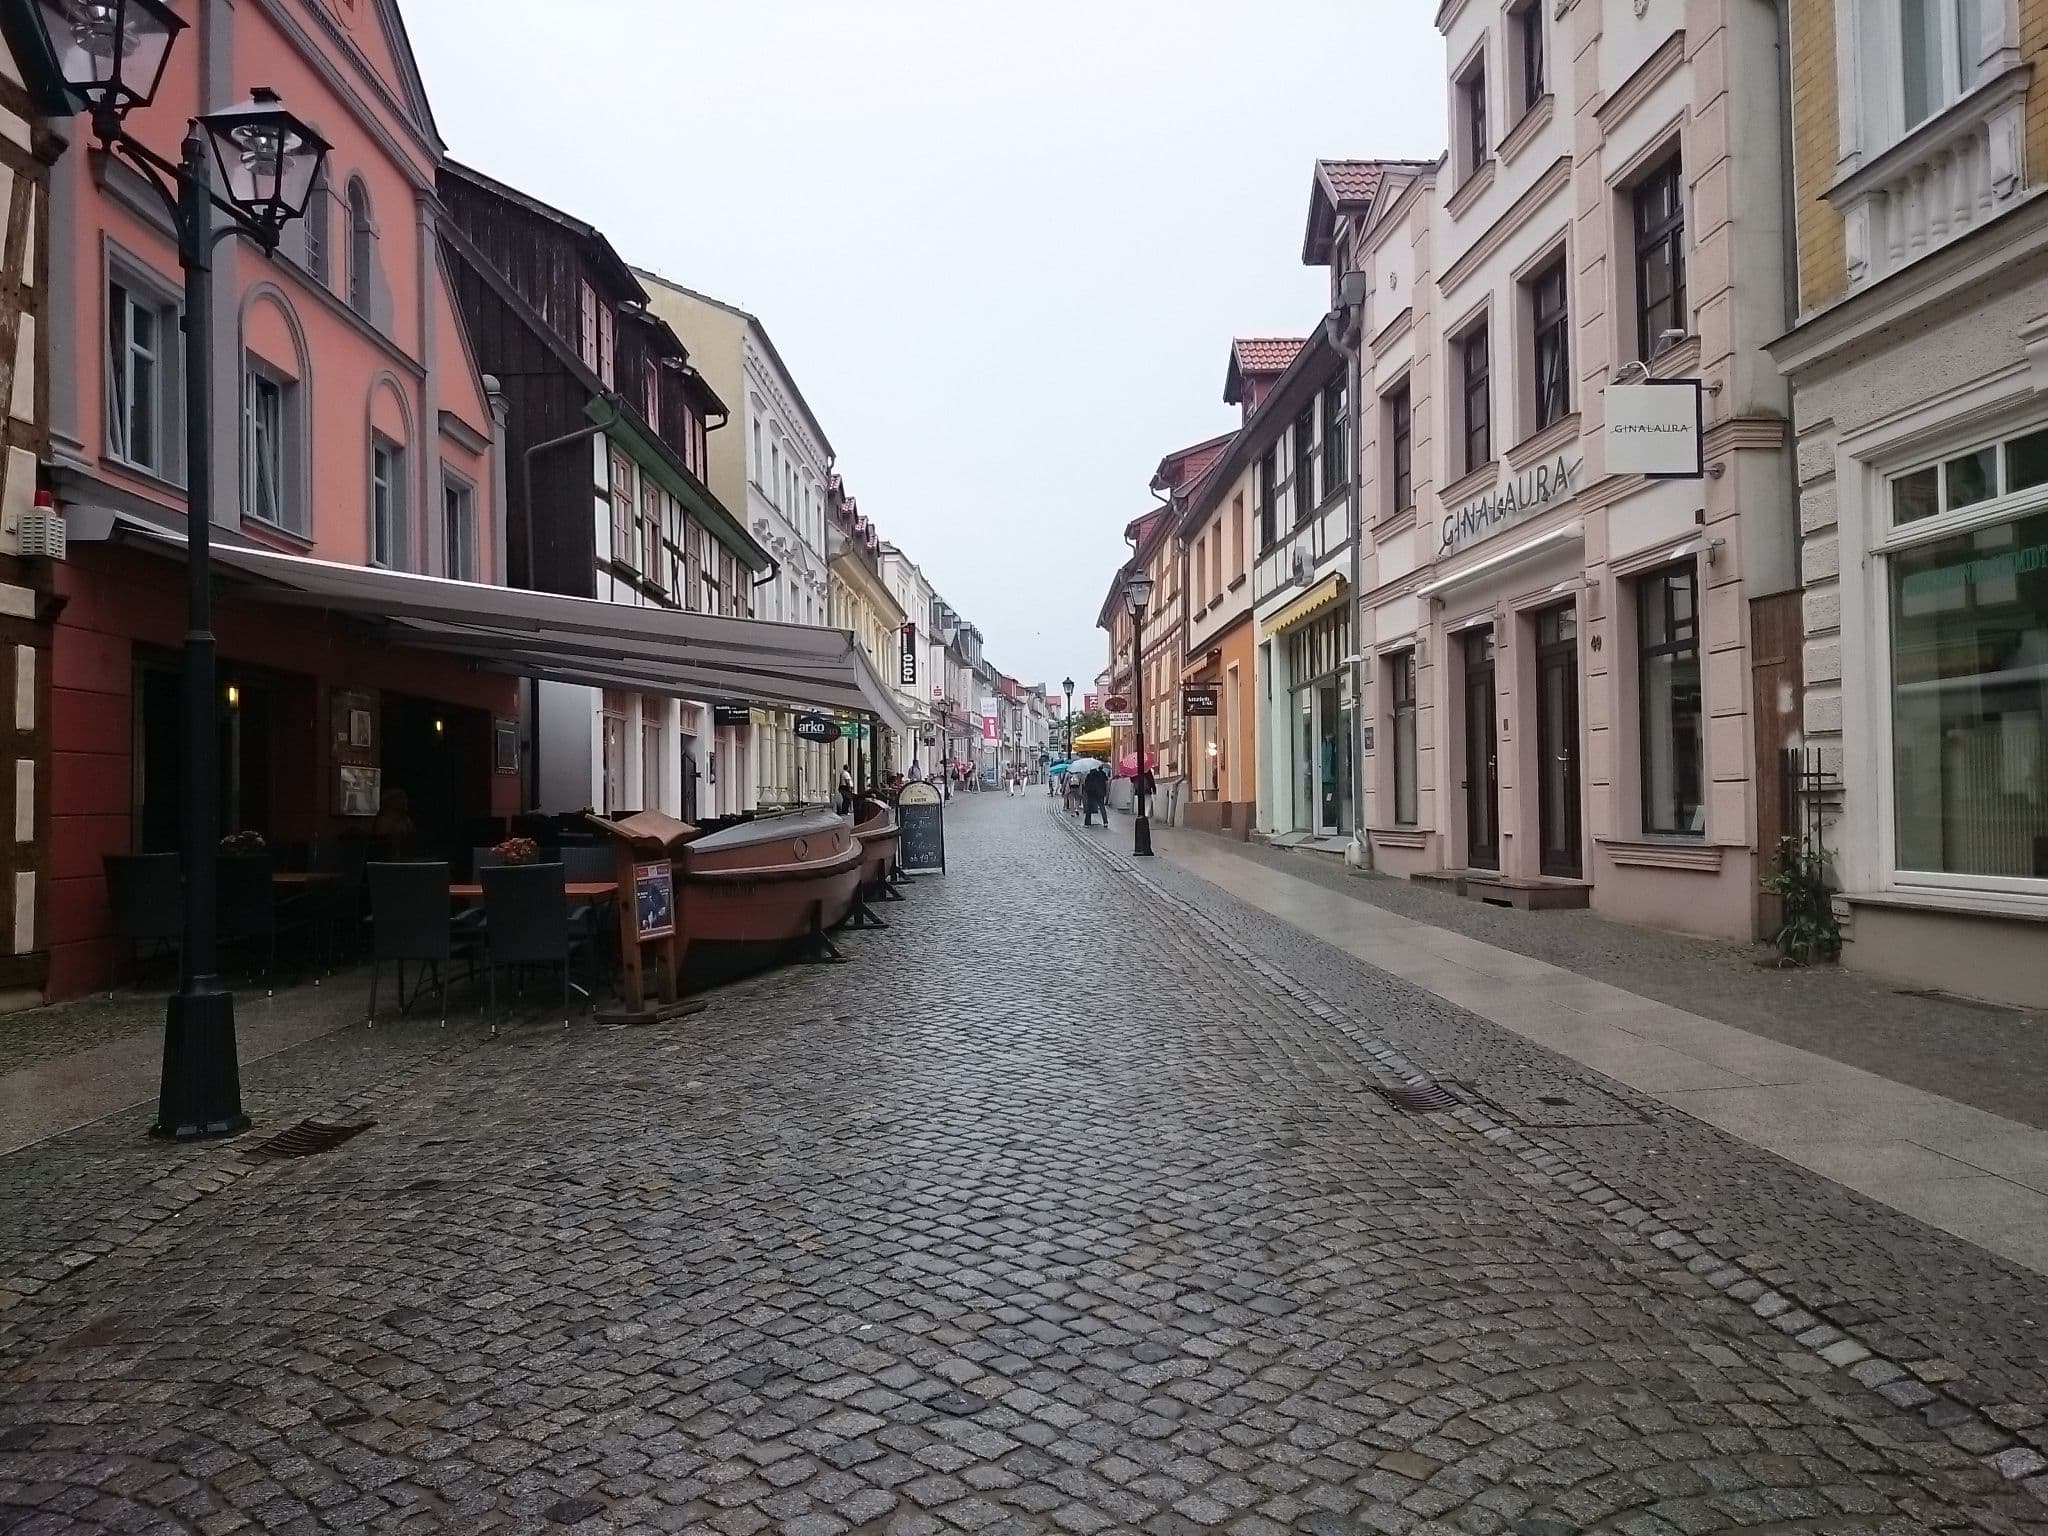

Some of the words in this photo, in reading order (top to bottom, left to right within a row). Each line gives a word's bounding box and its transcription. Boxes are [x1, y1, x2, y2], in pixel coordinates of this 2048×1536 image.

[1614, 424, 1688, 433] GINALAURA
[1442, 456, 1570, 546] GINALAURA
[903, 653, 914, 682] FOTO
[799, 720, 825, 732] arko
